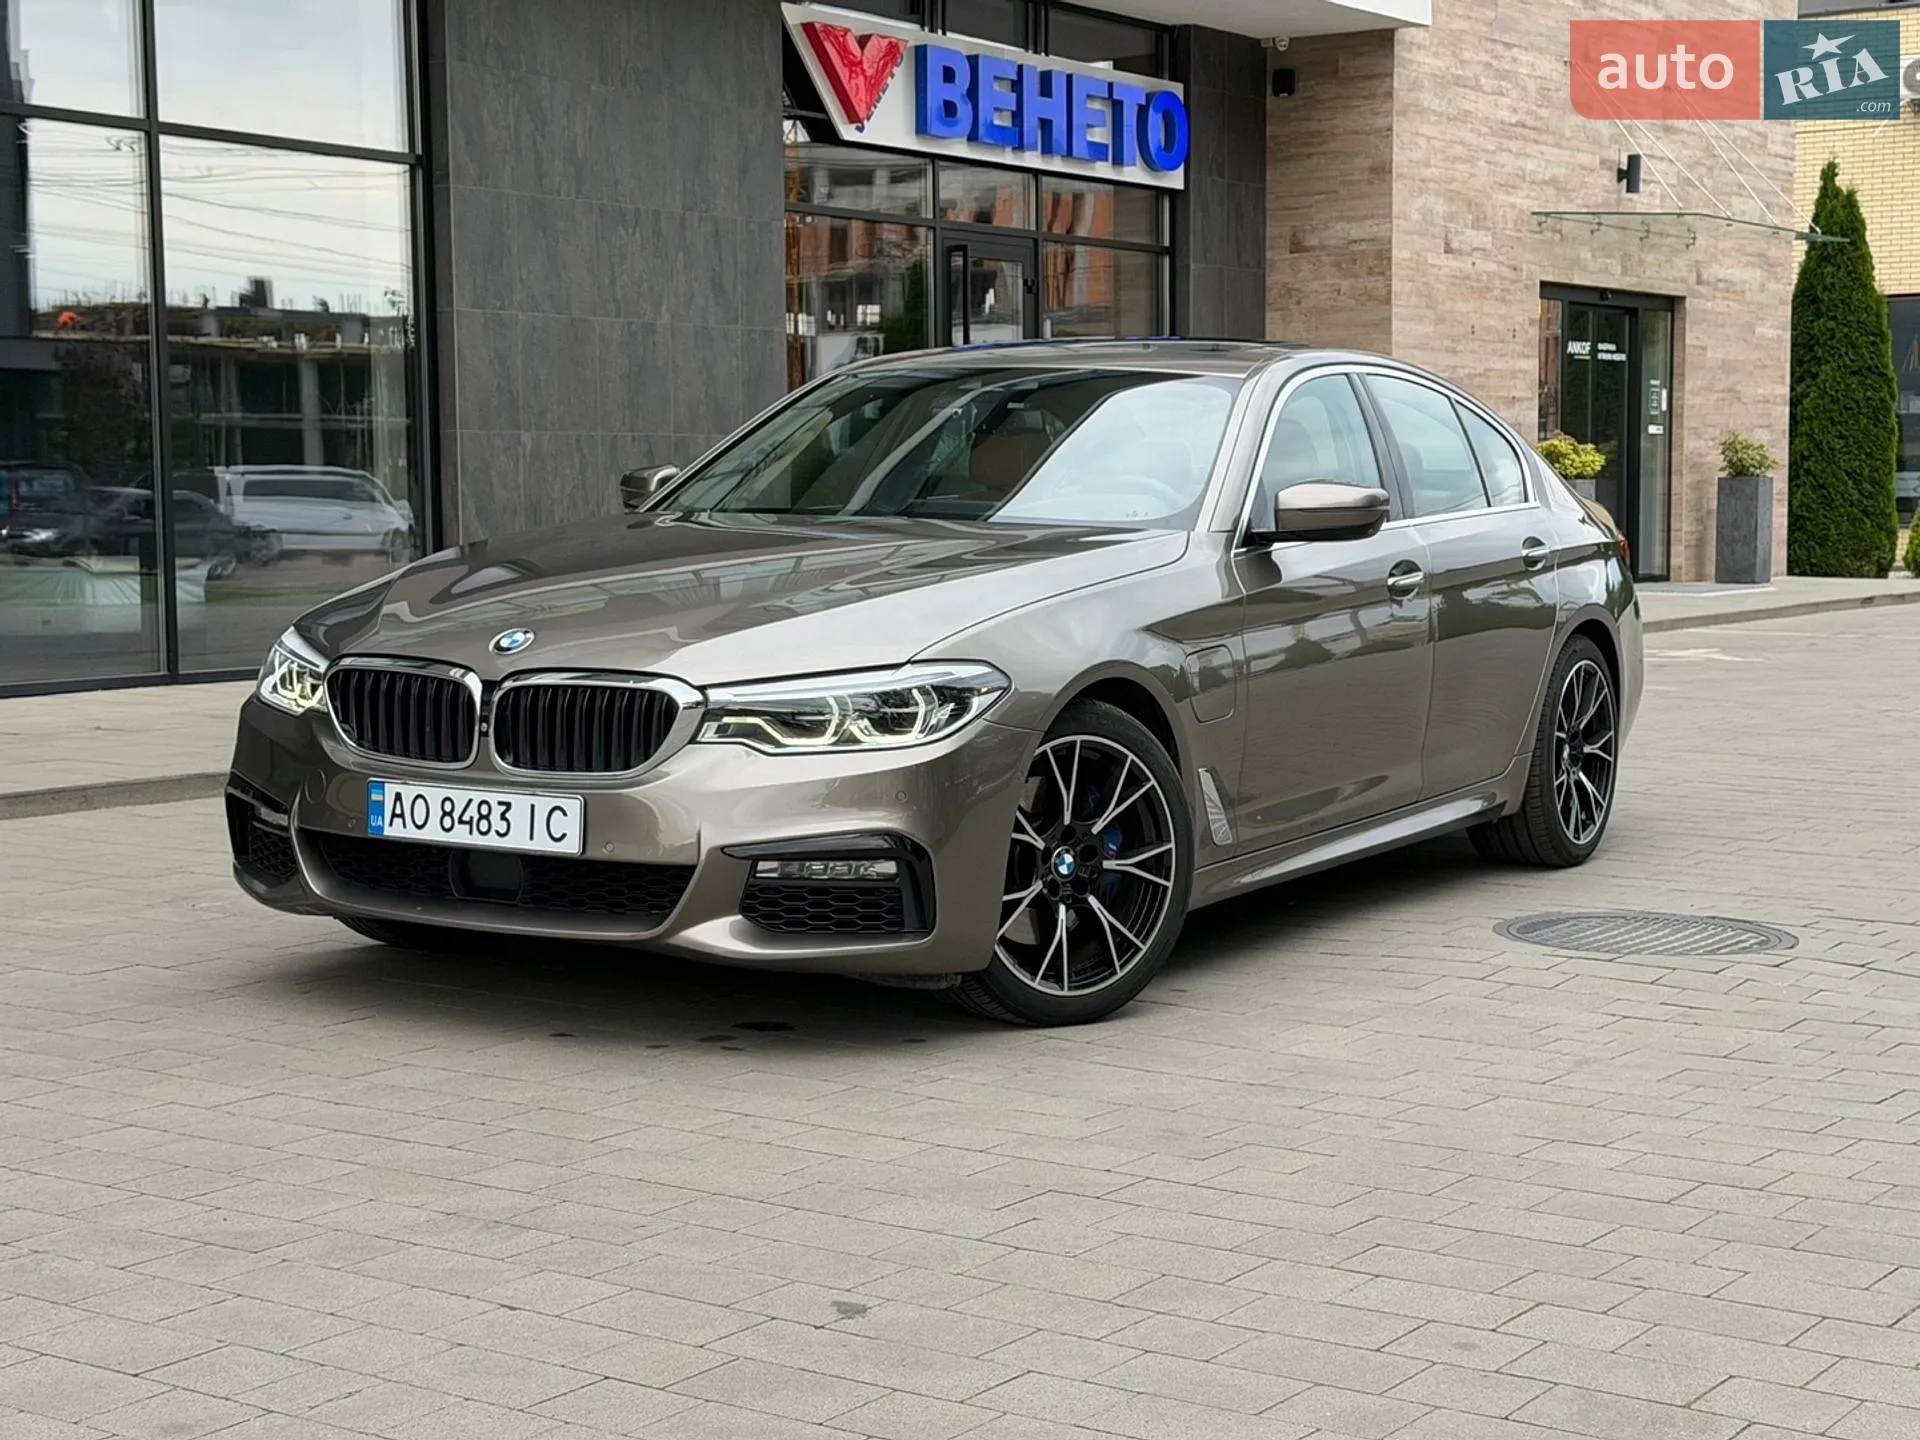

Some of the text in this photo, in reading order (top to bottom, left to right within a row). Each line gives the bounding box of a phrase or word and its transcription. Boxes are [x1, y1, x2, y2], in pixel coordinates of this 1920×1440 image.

[915, 44, 1190, 172] ВЕНЕТО
[371, 815, 383, 827] UA
[388, 791, 568, 843] AO 8483 IC
